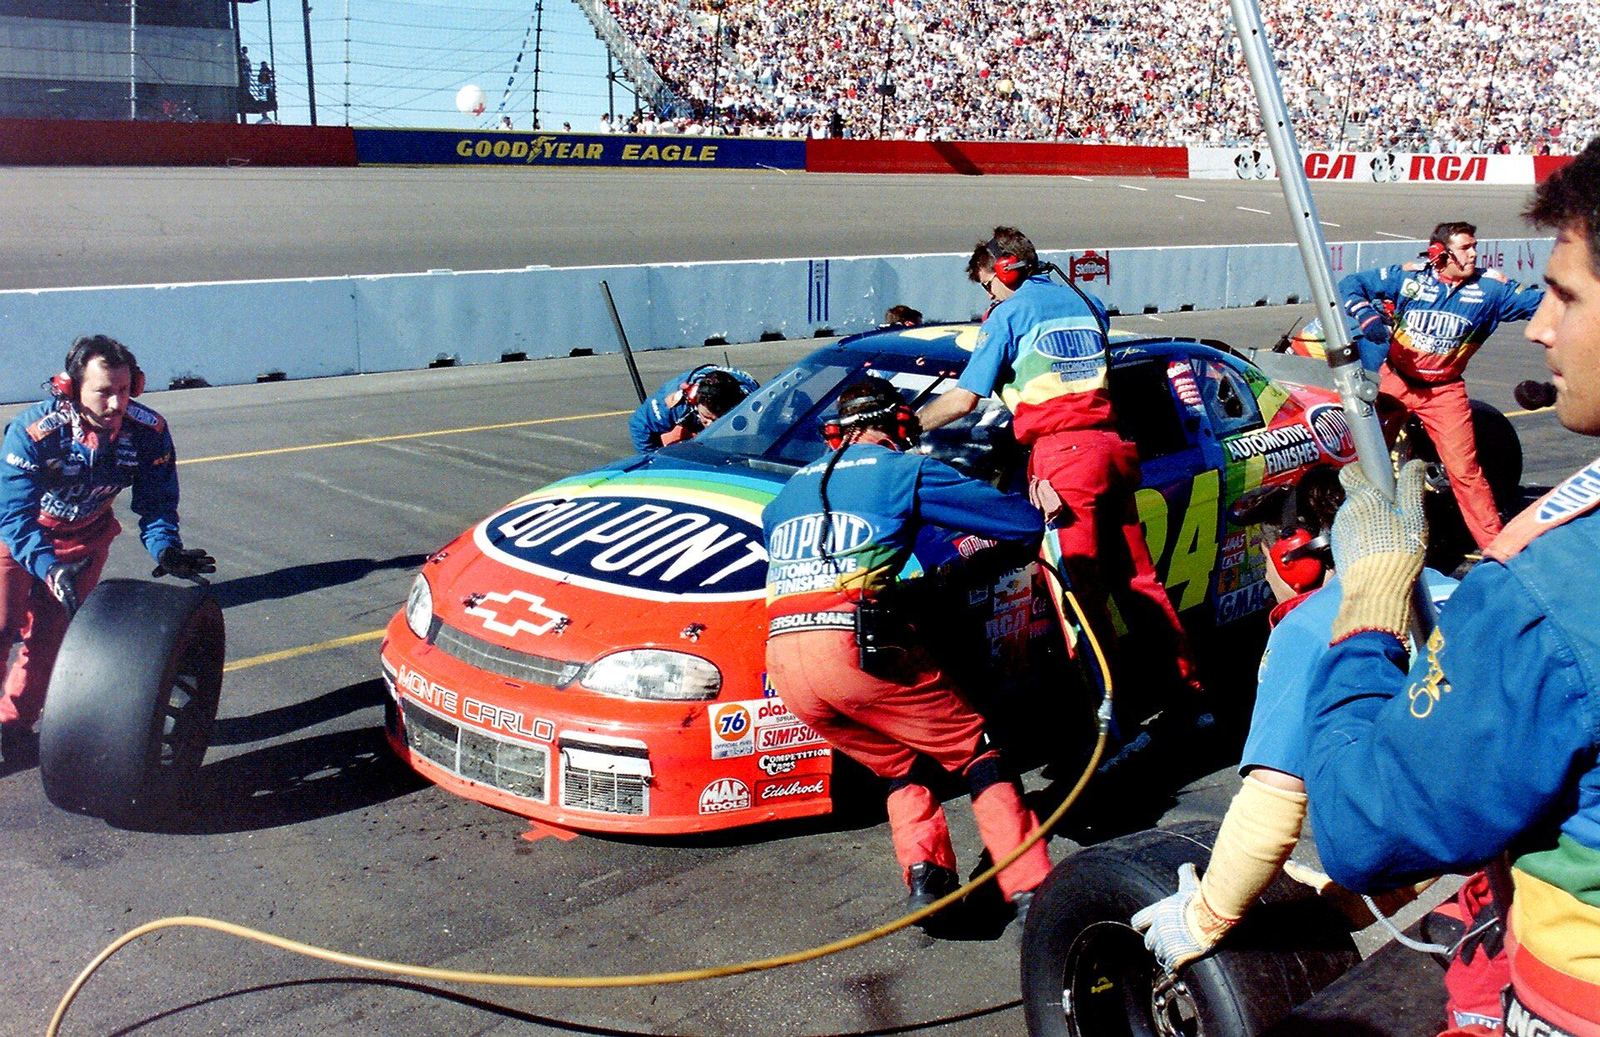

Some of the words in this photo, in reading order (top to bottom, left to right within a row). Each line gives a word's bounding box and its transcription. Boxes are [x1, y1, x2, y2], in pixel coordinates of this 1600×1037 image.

[621, 144, 718, 161] EAGLE
[1275, 152, 1356, 180] CA
[1408, 155, 1488, 182] RCA
[1407, 311, 1427, 332] DU
[1041, 332, 1064, 356] DU
[1226, 424, 1312, 461] AUTOMOTIVE
[1265, 441, 1320, 475] FINISHES
[498, 501, 621, 548] DU
[551, 504, 769, 587] PONT
[771, 518, 799, 561] DU
[775, 573, 837, 596] FINISHES
[397, 664, 458, 714] MONTE
[463, 698, 556, 742] CARLO
[719, 711, 745, 736] 76
[702, 780, 748, 803] MAC
[761, 780, 824, 799] Edelbrock
[701, 799, 748, 812] TOOLS
